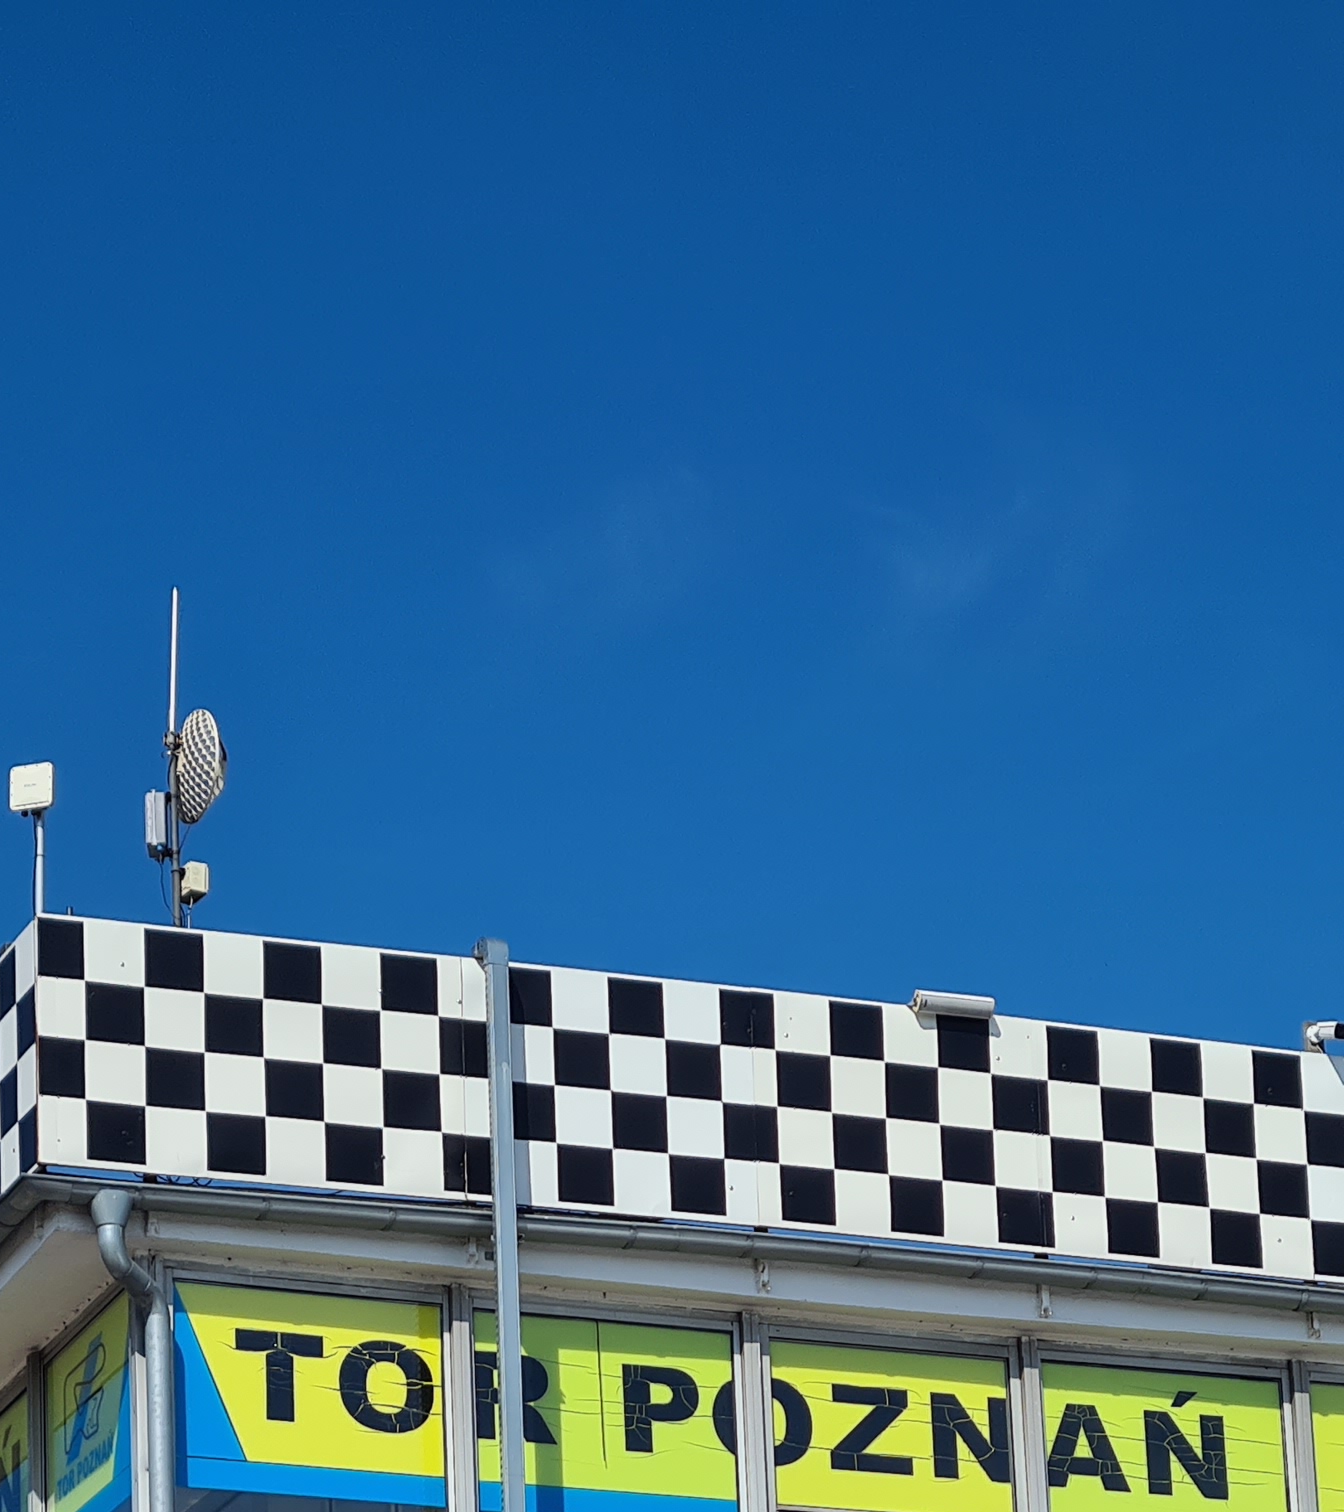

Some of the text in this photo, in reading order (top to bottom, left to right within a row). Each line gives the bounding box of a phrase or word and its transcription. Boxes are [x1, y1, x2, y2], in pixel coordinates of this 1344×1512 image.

[57, 1429, 114, 1500] TOR POZNAŃ
[235, 1327, 558, 1445] TOR
[621, 1363, 1229, 1501] POZNAŃ
